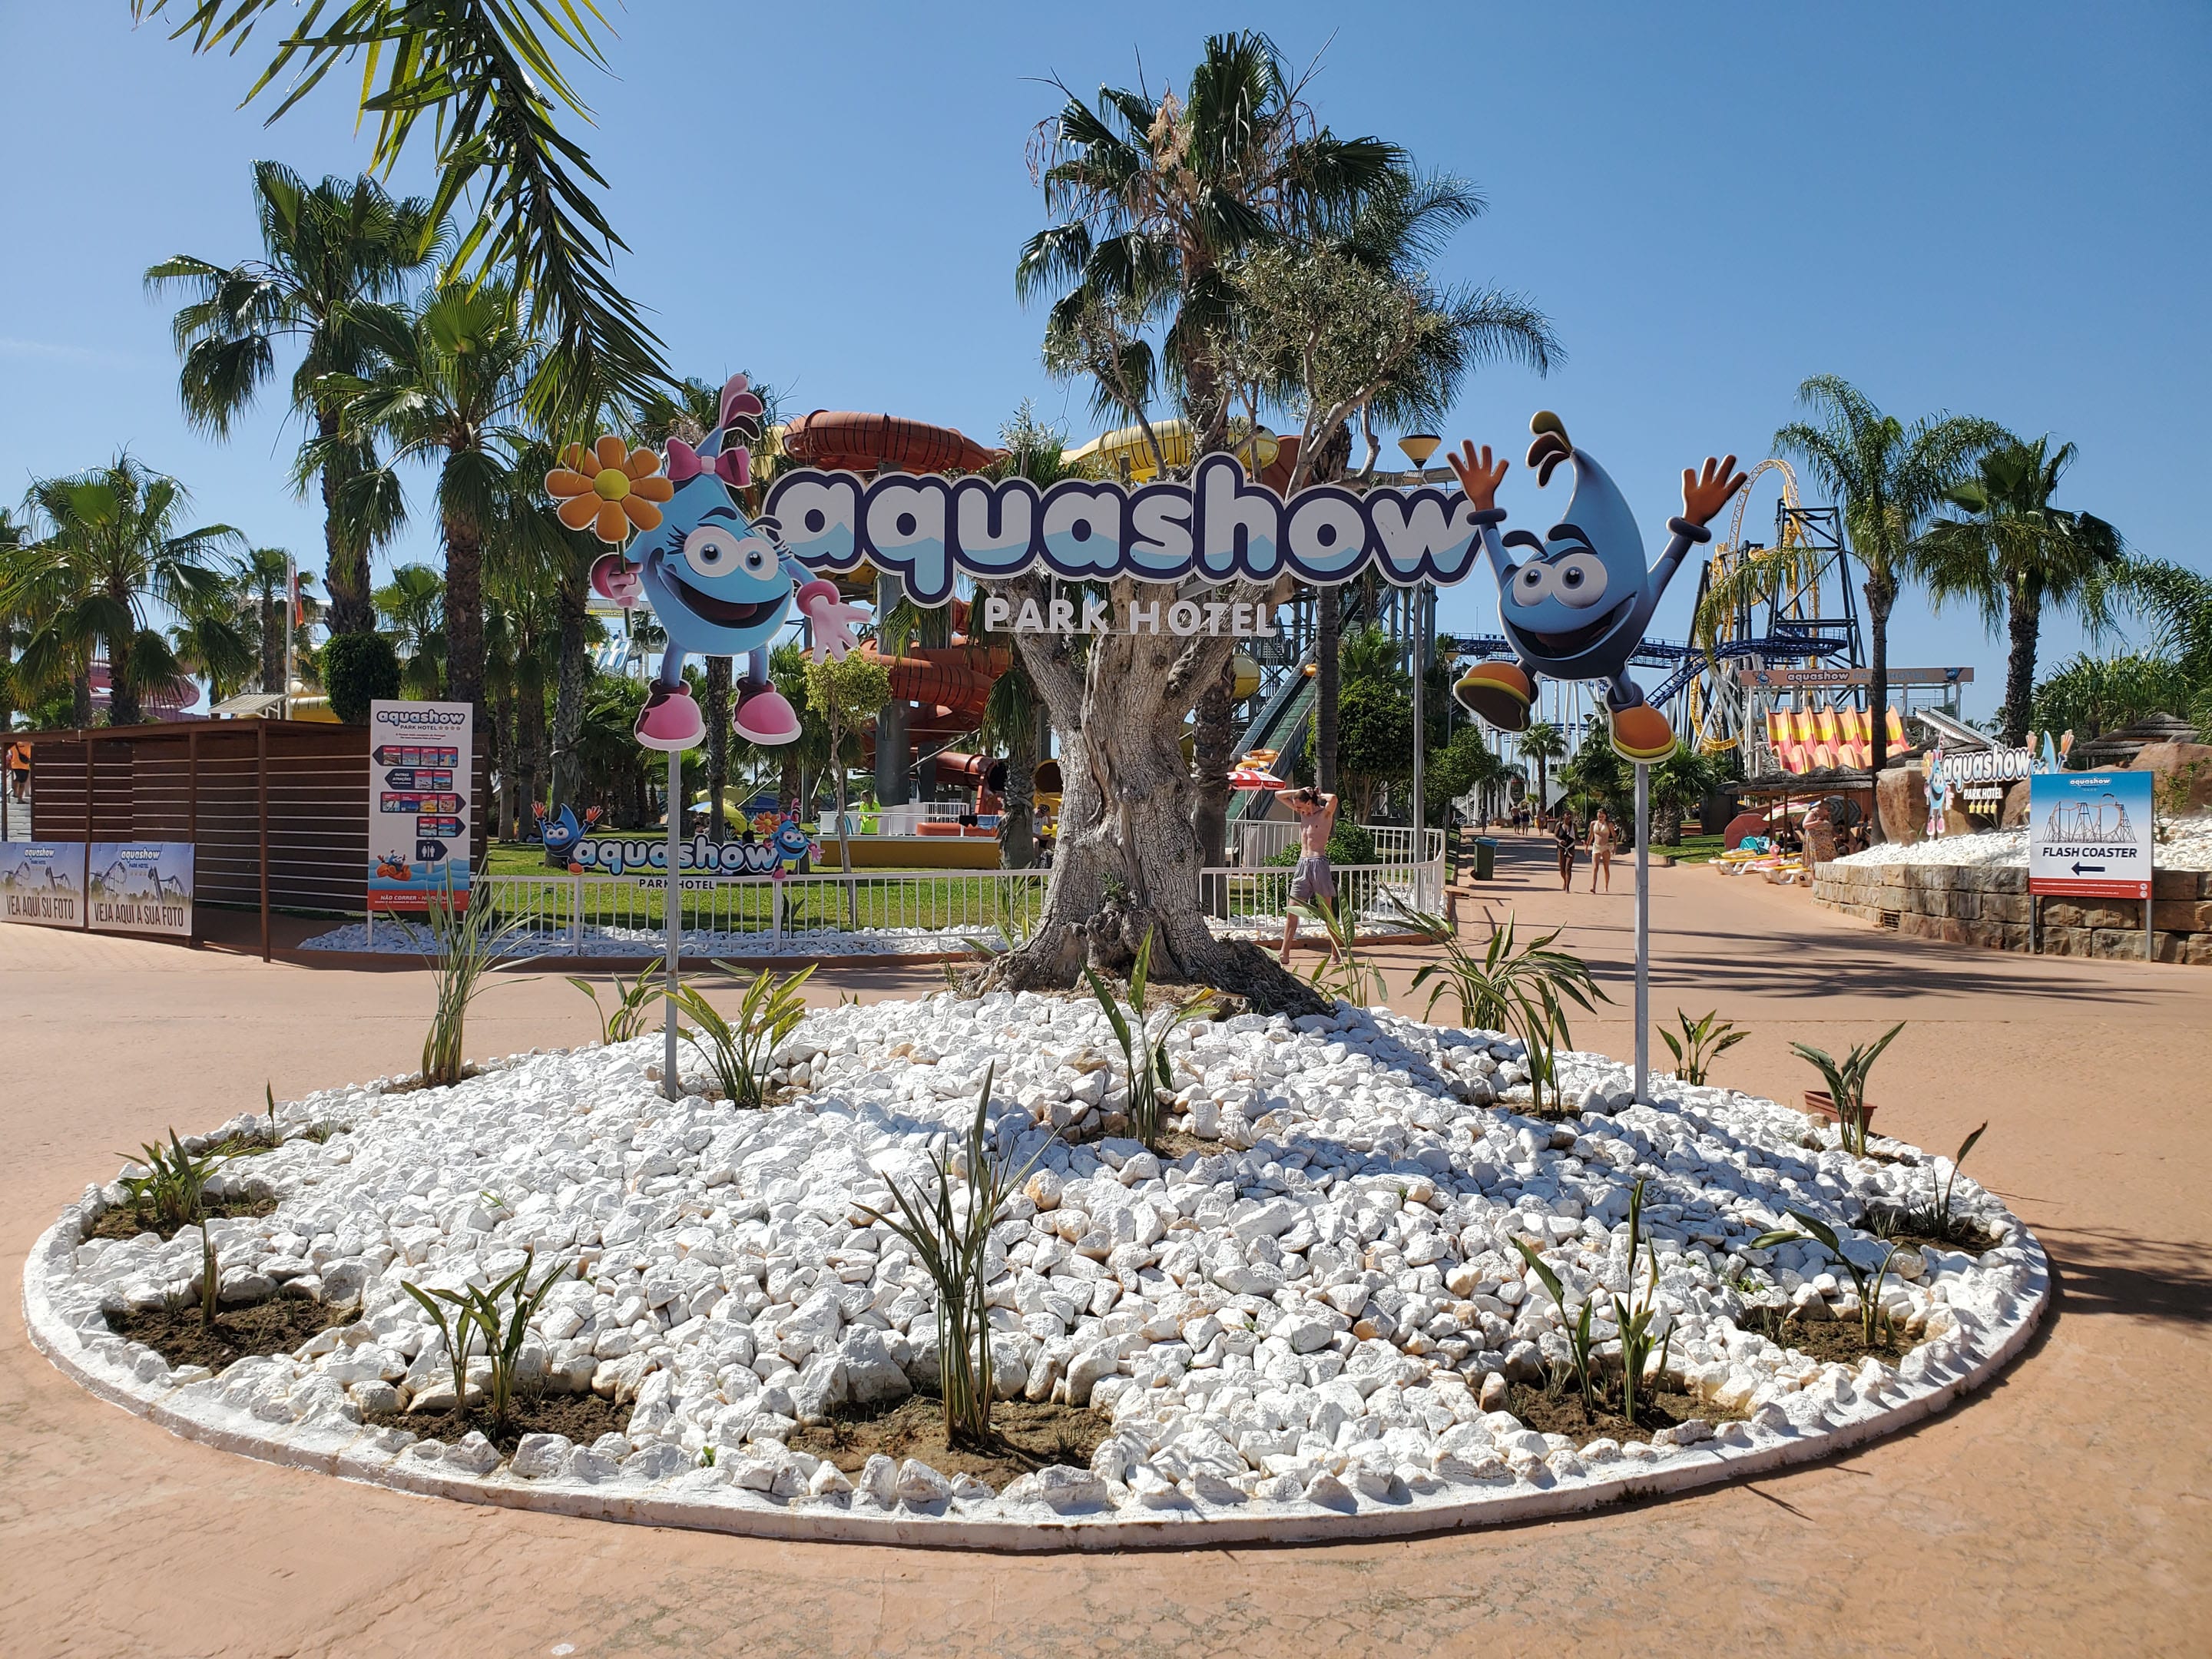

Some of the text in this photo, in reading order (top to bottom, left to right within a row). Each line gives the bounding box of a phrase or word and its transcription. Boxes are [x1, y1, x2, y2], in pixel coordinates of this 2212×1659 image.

[767, 454, 1479, 605] aquashow
[985, 598, 1277, 637] PARK HOTEL
[1786, 671, 1849, 683] aquashow
[1888, 671, 1928, 680] HOTEL
[376, 709, 465, 727] aquashow
[1942, 743, 2031, 793] aquashow
[2069, 777, 2112, 786] aquashow
[1963, 787, 2003, 800] PARK HOTEL
[25, 846, 55, 860] aquashow
[121, 847, 162, 863] aquashow
[574, 835, 778, 876] aquashow
[2042, 847, 2137, 858] FLASH COASTER
[6, 895, 22, 916] VEA
[42, 896, 52, 918] SU
[54, 897, 74, 919] FOTO
[94, 902, 184, 927] VEJA AQUI A SUA FOTO
